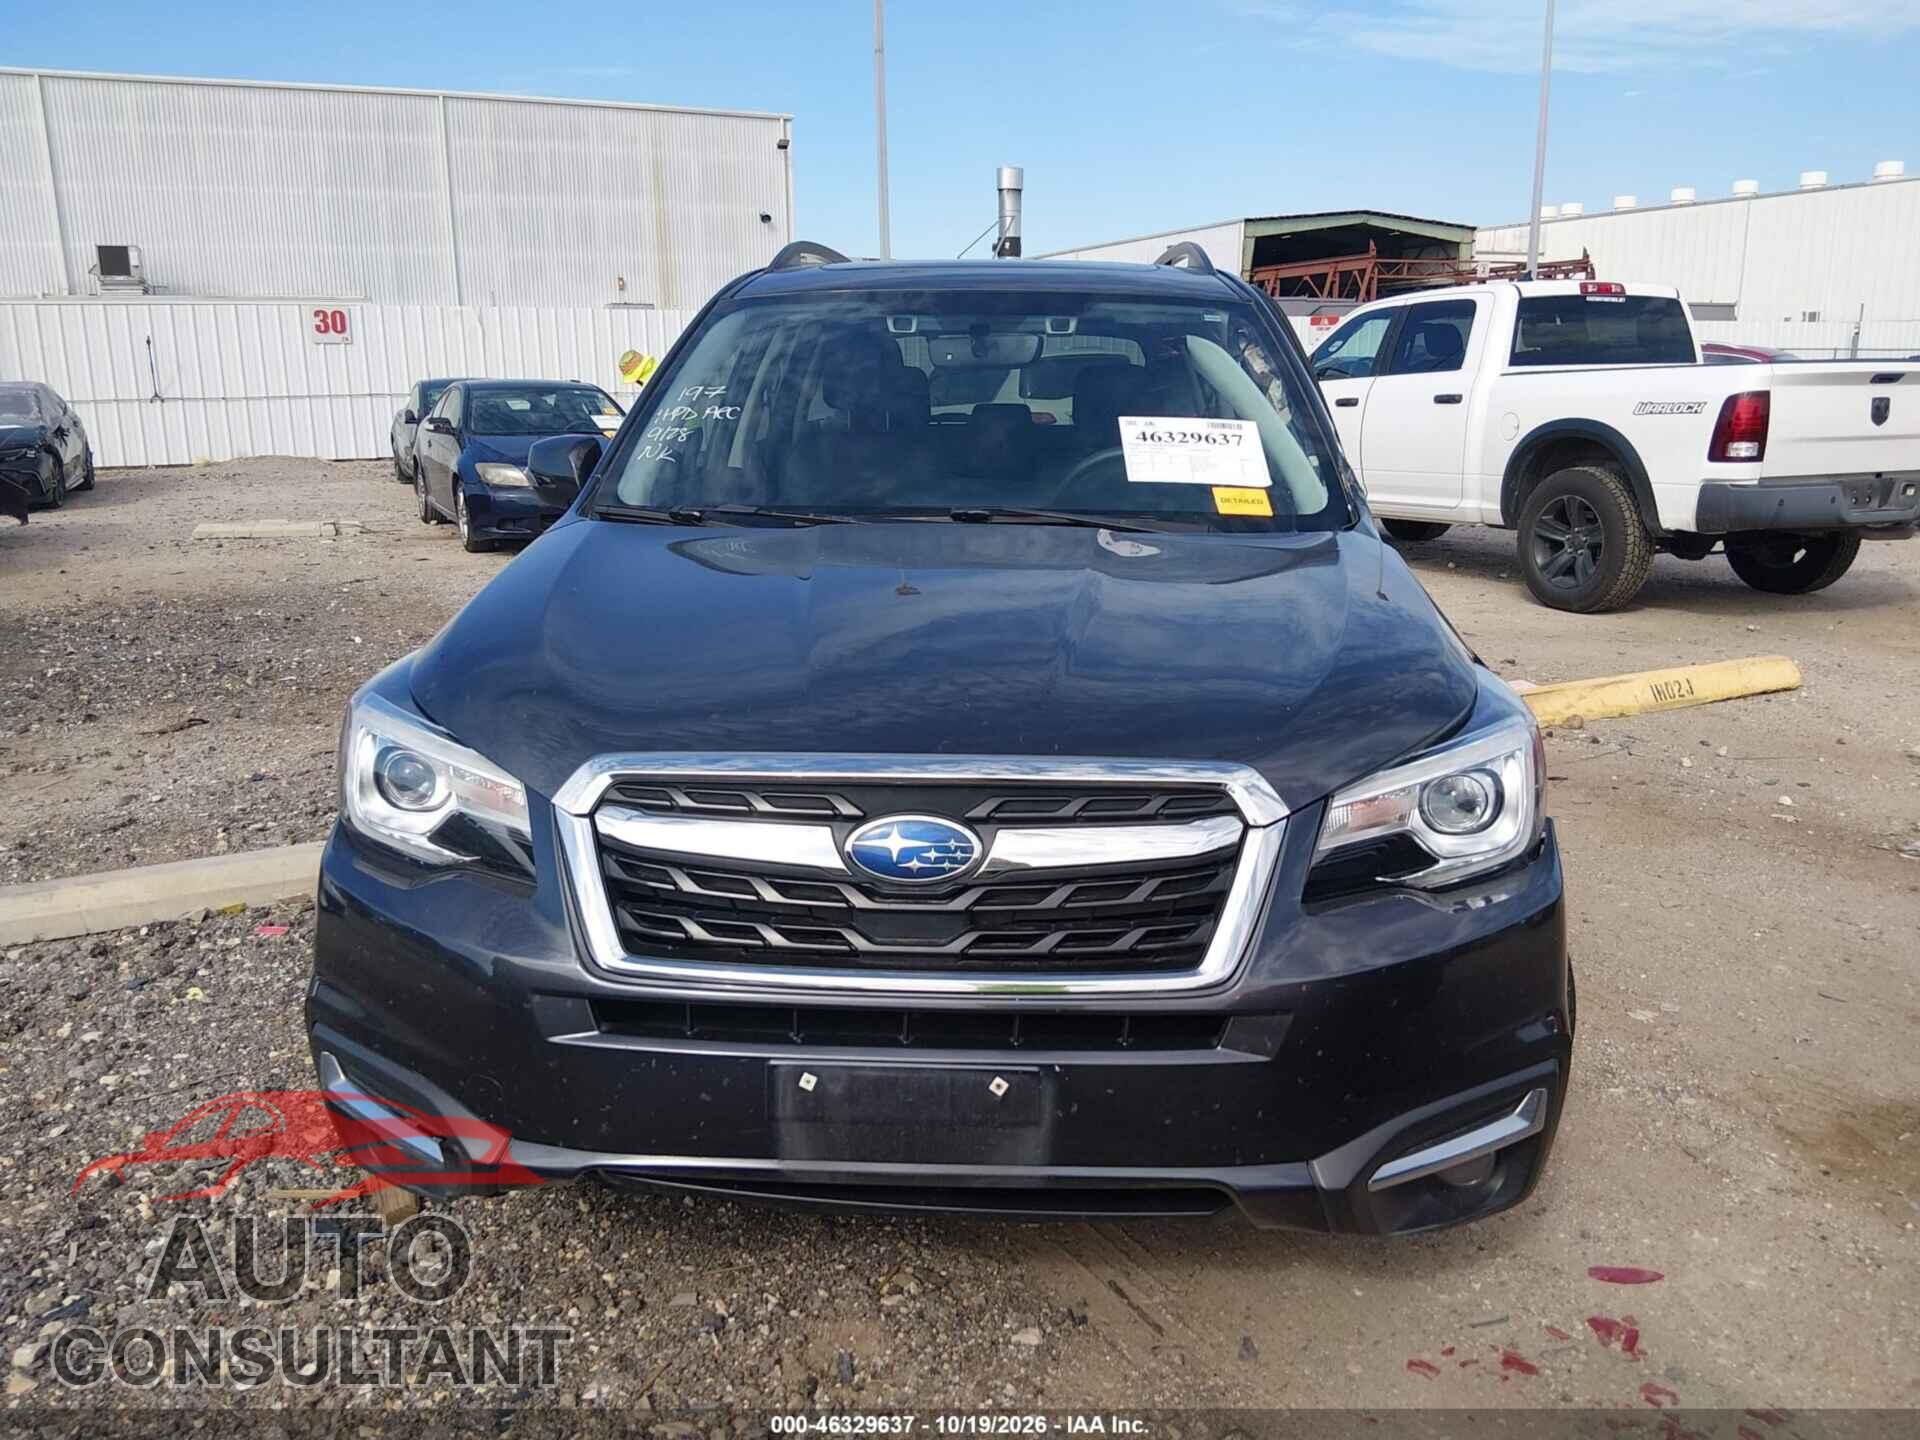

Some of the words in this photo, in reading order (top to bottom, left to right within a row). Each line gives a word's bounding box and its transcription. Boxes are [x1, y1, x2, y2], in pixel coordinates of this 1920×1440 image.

[313, 309, 347, 334] 30
[678, 386, 727, 401] 197
[1633, 401, 1708, 415] WARLOCK
[1136, 431, 1243, 446] 46329637
